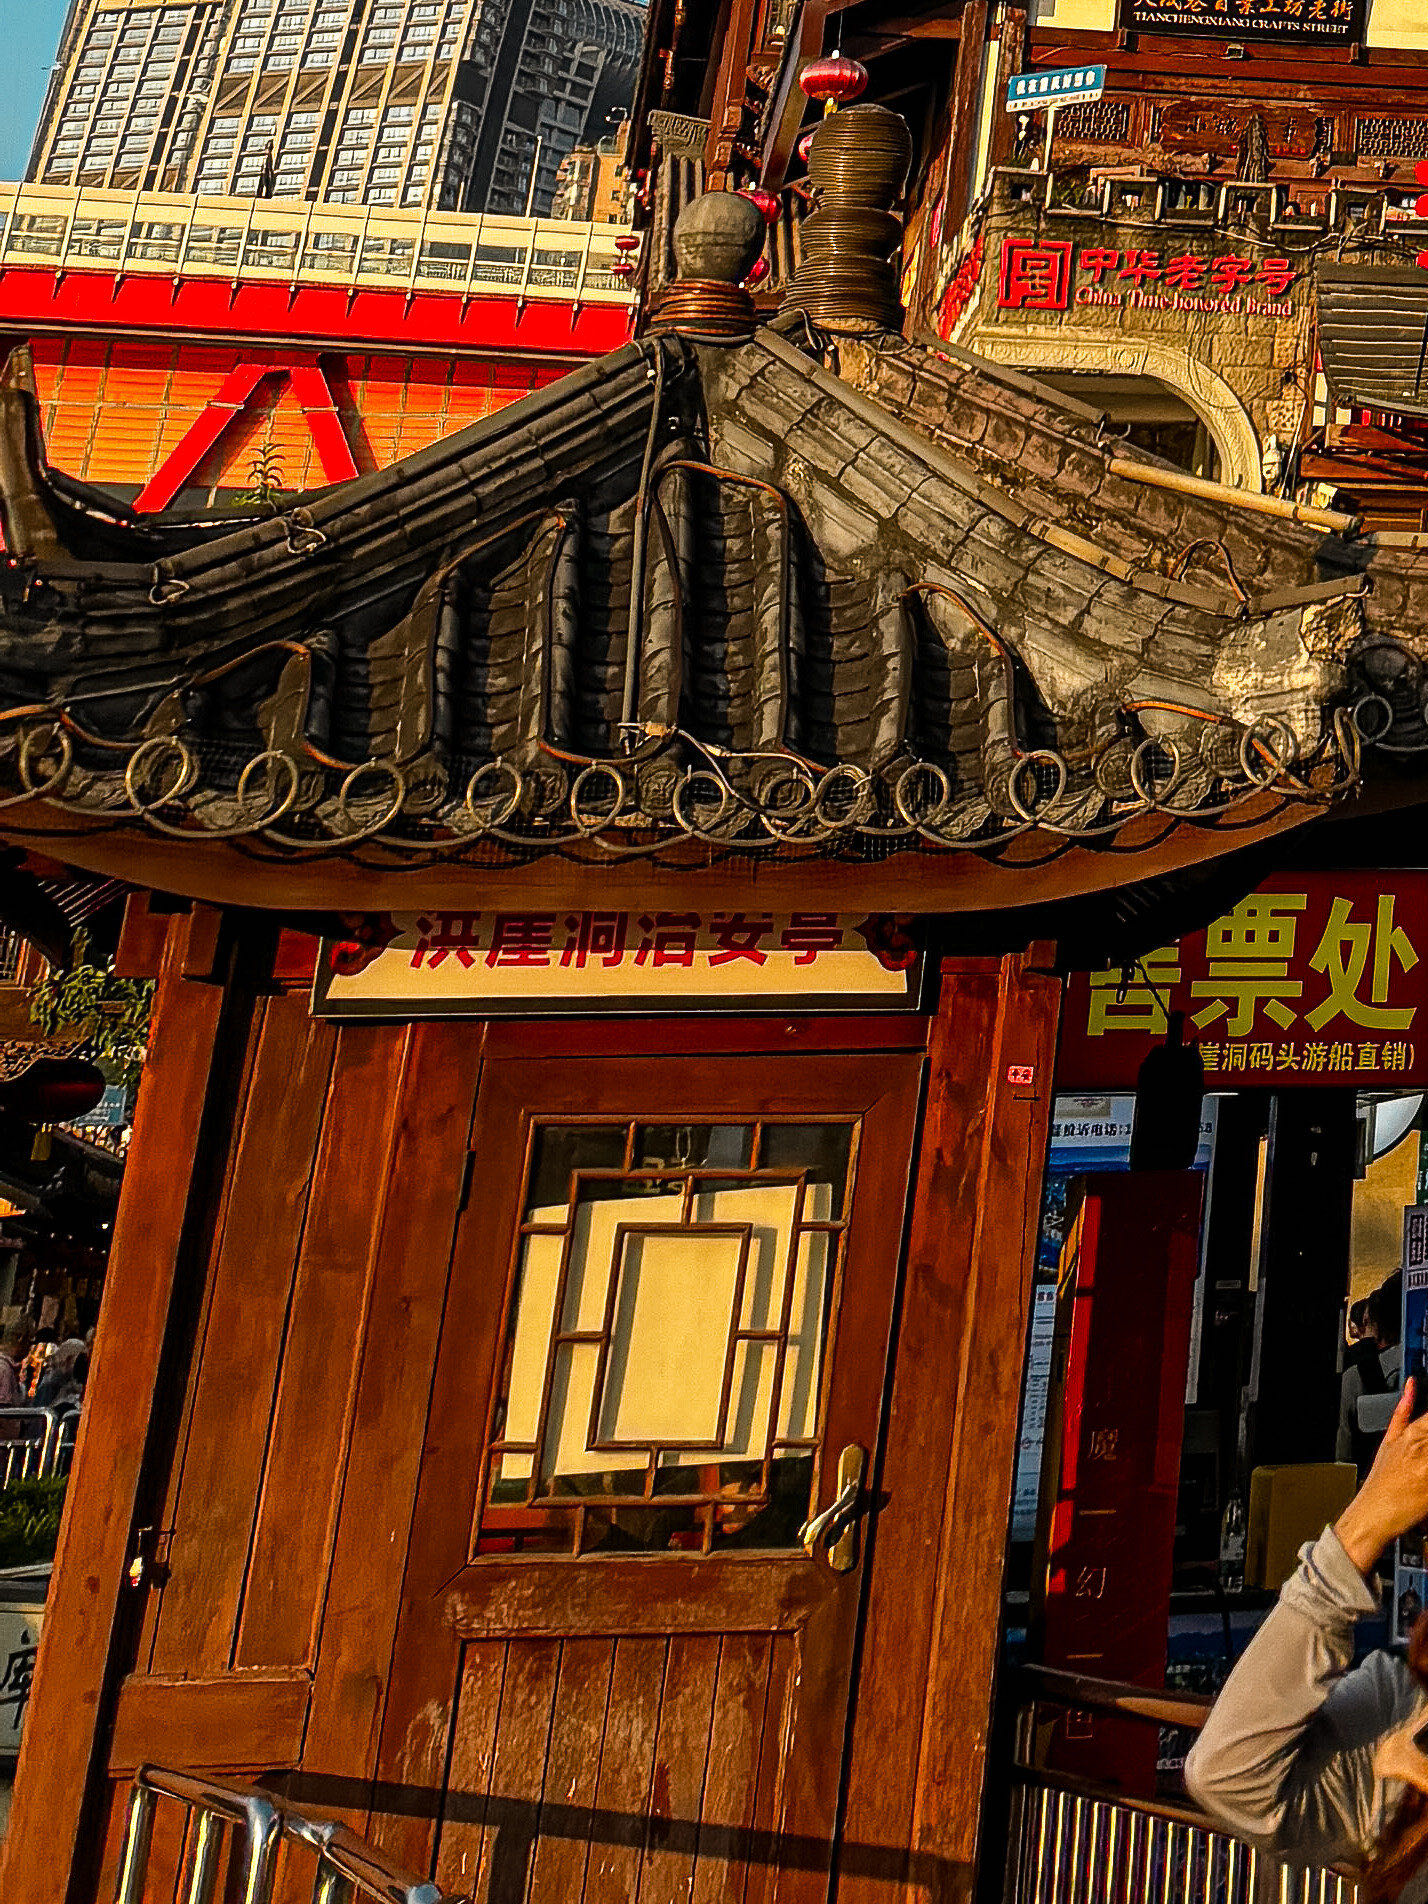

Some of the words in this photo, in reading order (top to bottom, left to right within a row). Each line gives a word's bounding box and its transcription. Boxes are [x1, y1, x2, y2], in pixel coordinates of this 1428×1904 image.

[1079, 247, 1298, 295] 中华老字号
[1075, 285, 1122, 306] China
[1127, 288, 1241, 315] Time-honored
[1246, 297, 1293, 318] Brand
[1086, 892, 1424, 1035] 售票处
[1182, 1040, 1418, 1070] 崖洞码头游船直销
